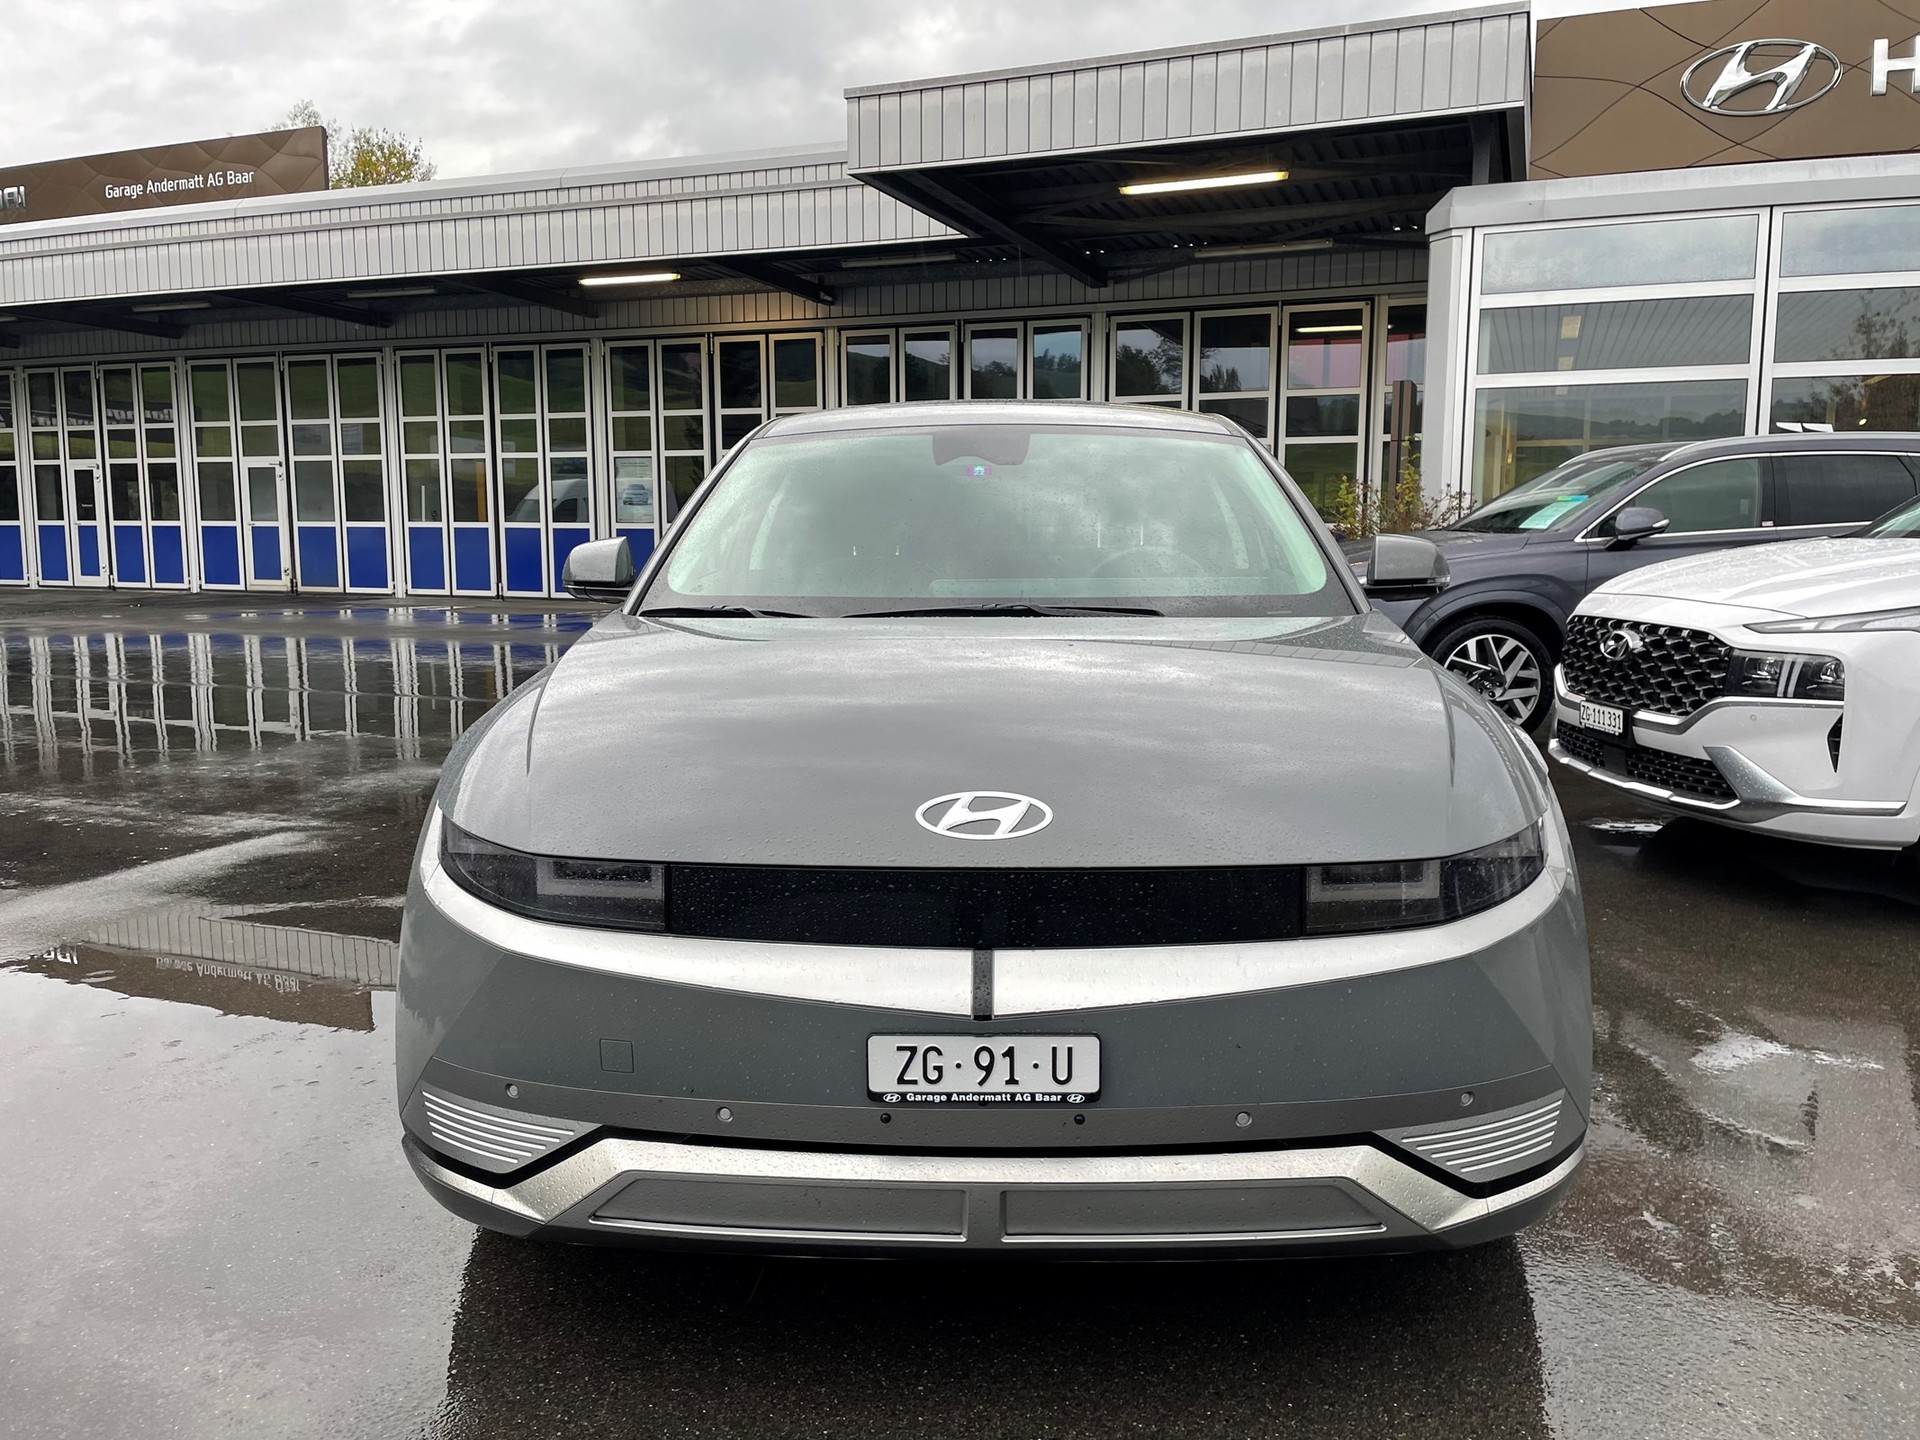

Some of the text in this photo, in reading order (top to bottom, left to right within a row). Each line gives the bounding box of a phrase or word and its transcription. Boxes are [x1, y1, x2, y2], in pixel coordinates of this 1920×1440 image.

[105, 170, 255, 199] Garage Andermatt AG Baar
[906, 1092, 1062, 1103] Garage Andermatt AG Baar
